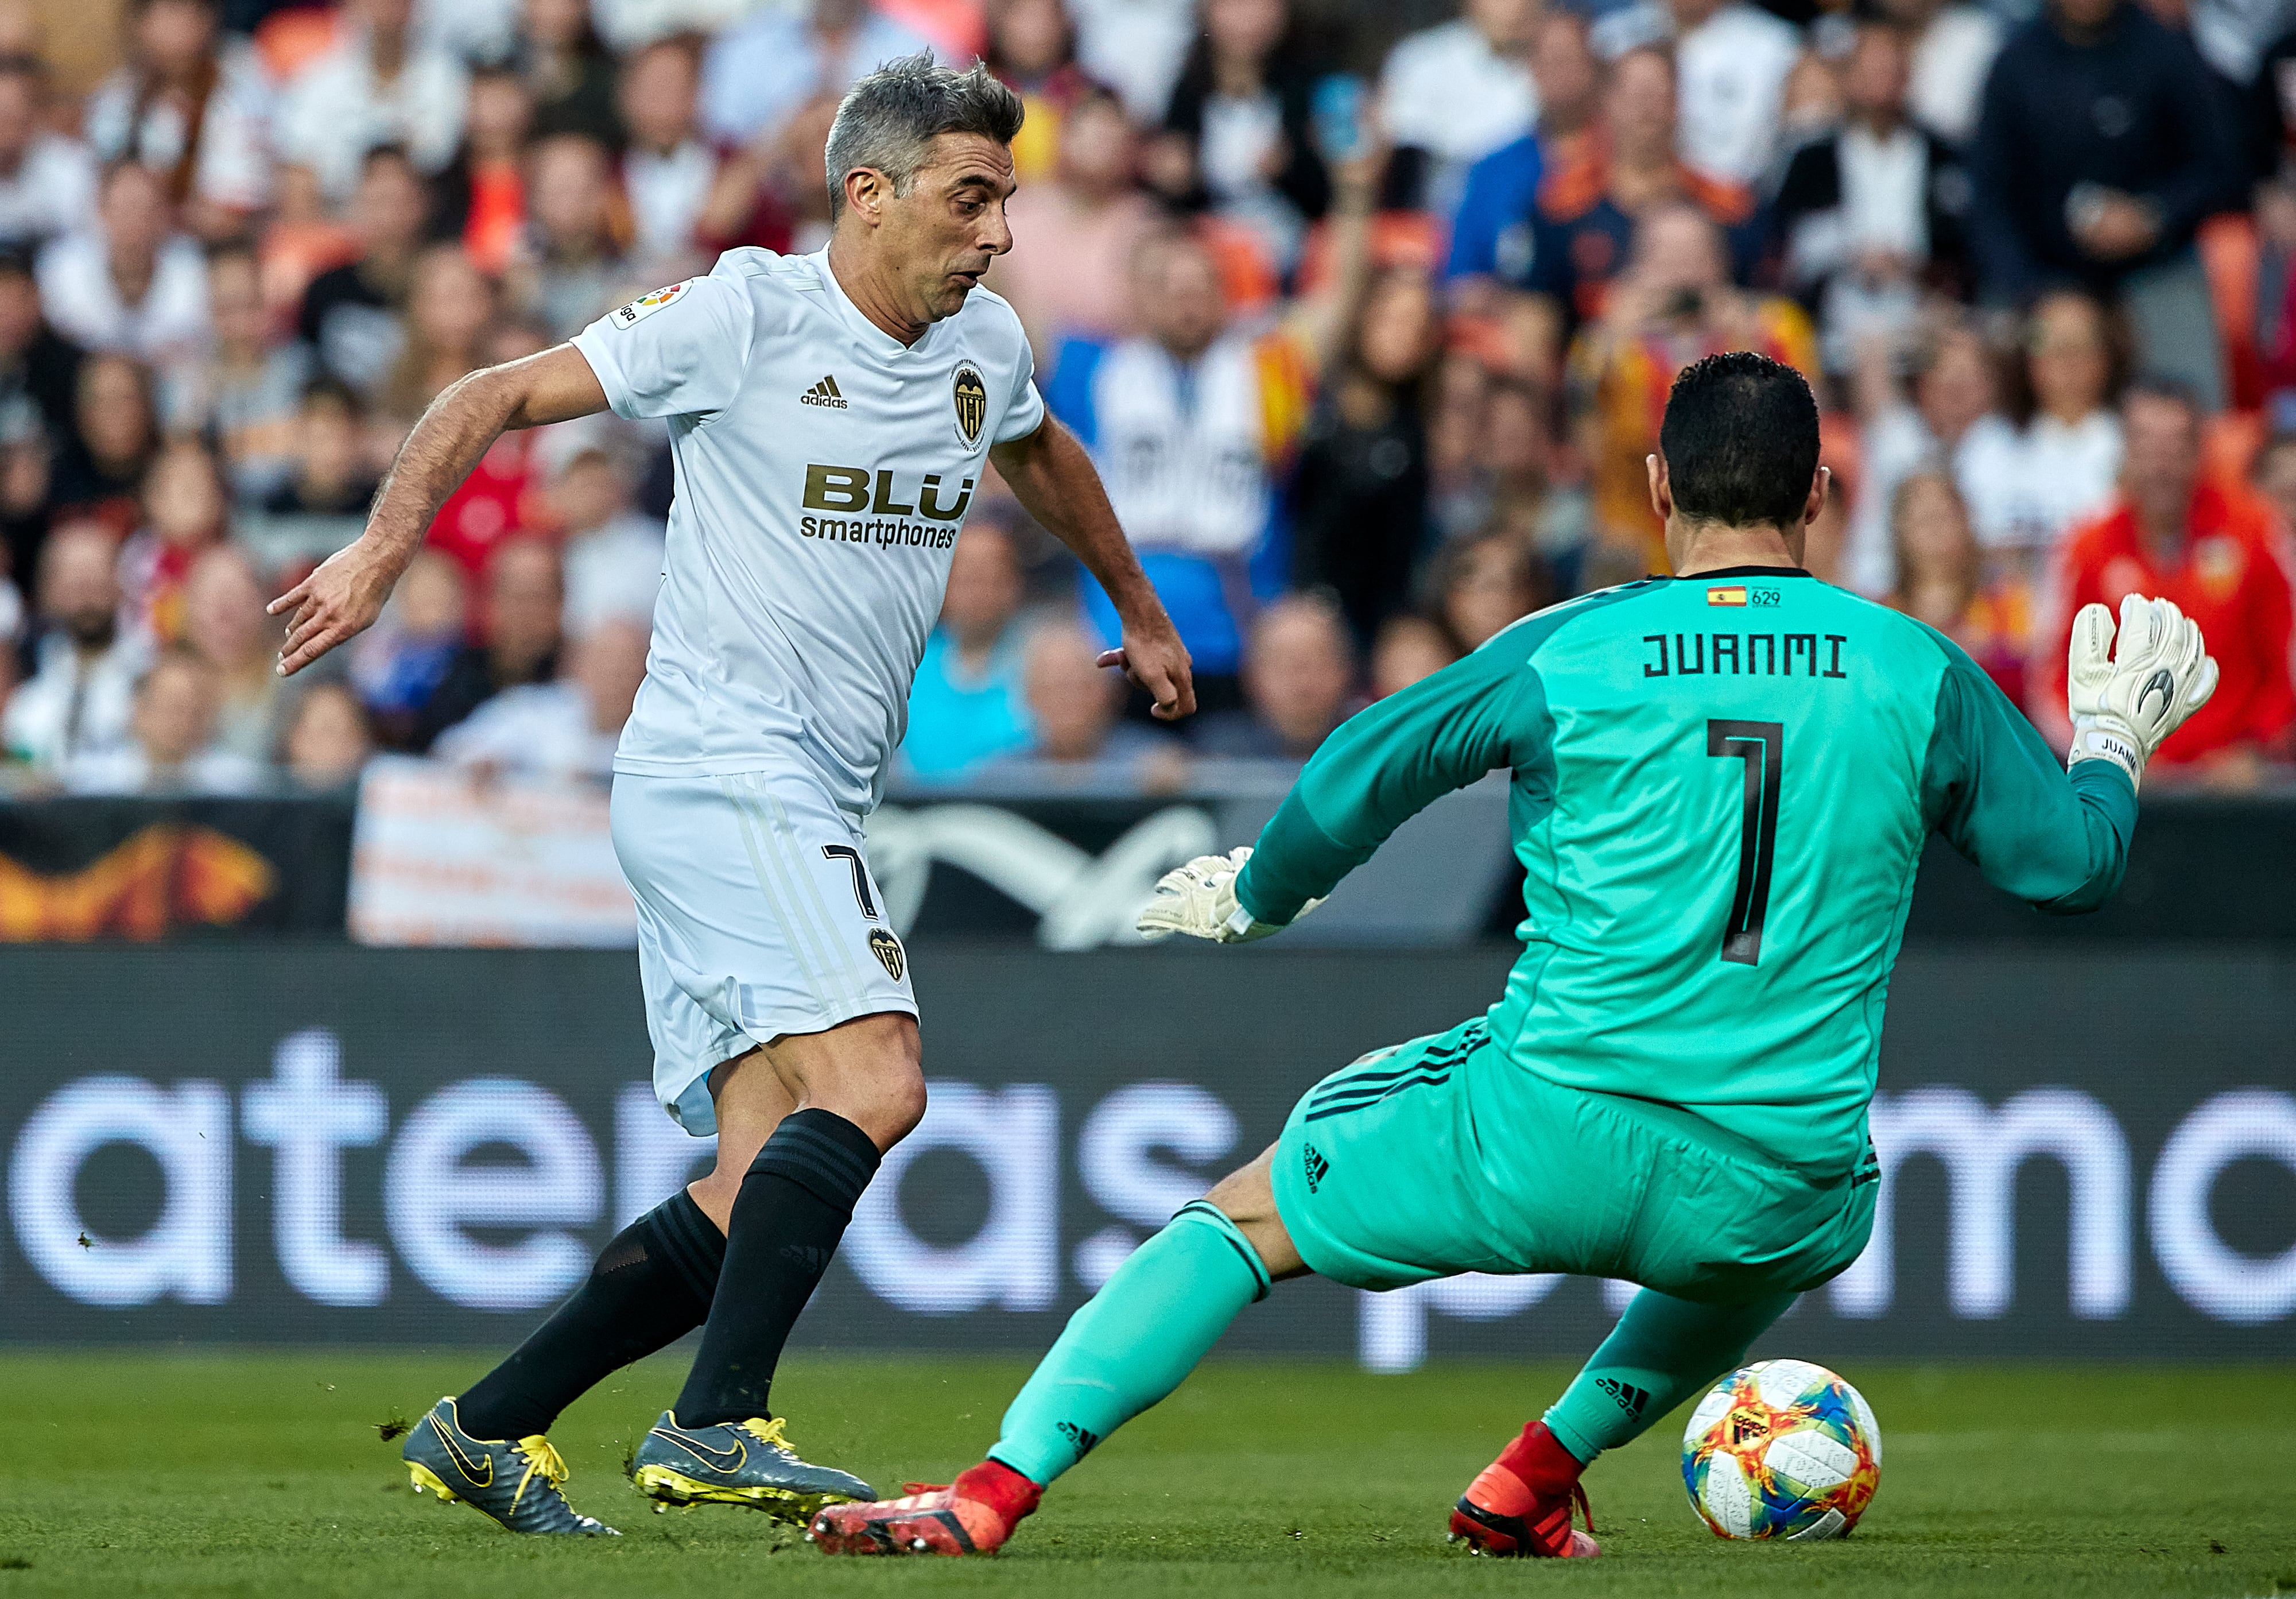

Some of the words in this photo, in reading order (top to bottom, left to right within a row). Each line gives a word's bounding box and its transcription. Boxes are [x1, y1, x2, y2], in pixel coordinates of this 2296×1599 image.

[800, 394, 848, 409] adidas
[801, 517, 956, 550] smartphones
[1752, 590, 1781, 605] 629
[1643, 633, 1847, 679] JUANMI
[1708, 719, 1783, 967] 1
[821, 845, 878, 920] 7
[1304, 1143, 1318, 1194] adidas
[1595, 1379, 1640, 1423] adidas
